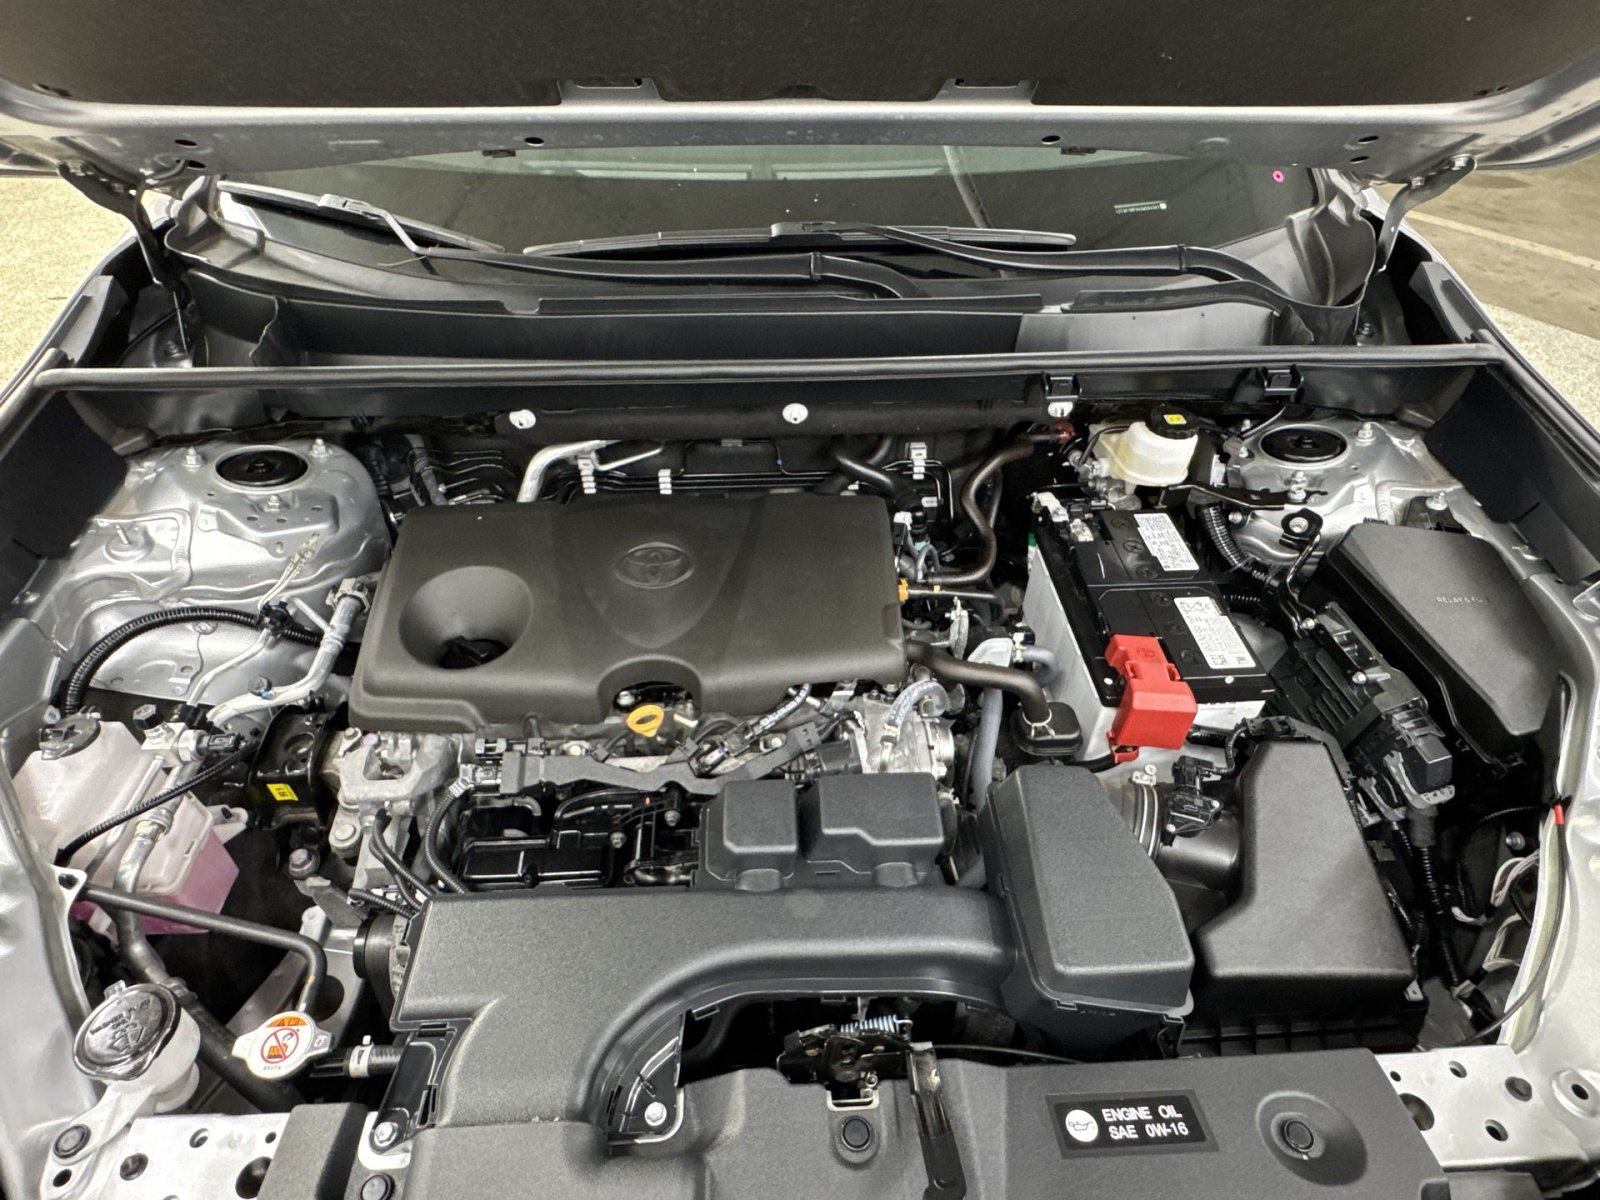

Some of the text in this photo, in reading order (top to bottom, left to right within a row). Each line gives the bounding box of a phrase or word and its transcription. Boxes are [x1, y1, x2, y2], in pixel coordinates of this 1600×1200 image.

[1101, 1105, 1183, 1122] ENGINE OIL
[1108, 1121, 1189, 1140] SAE 0W-16
